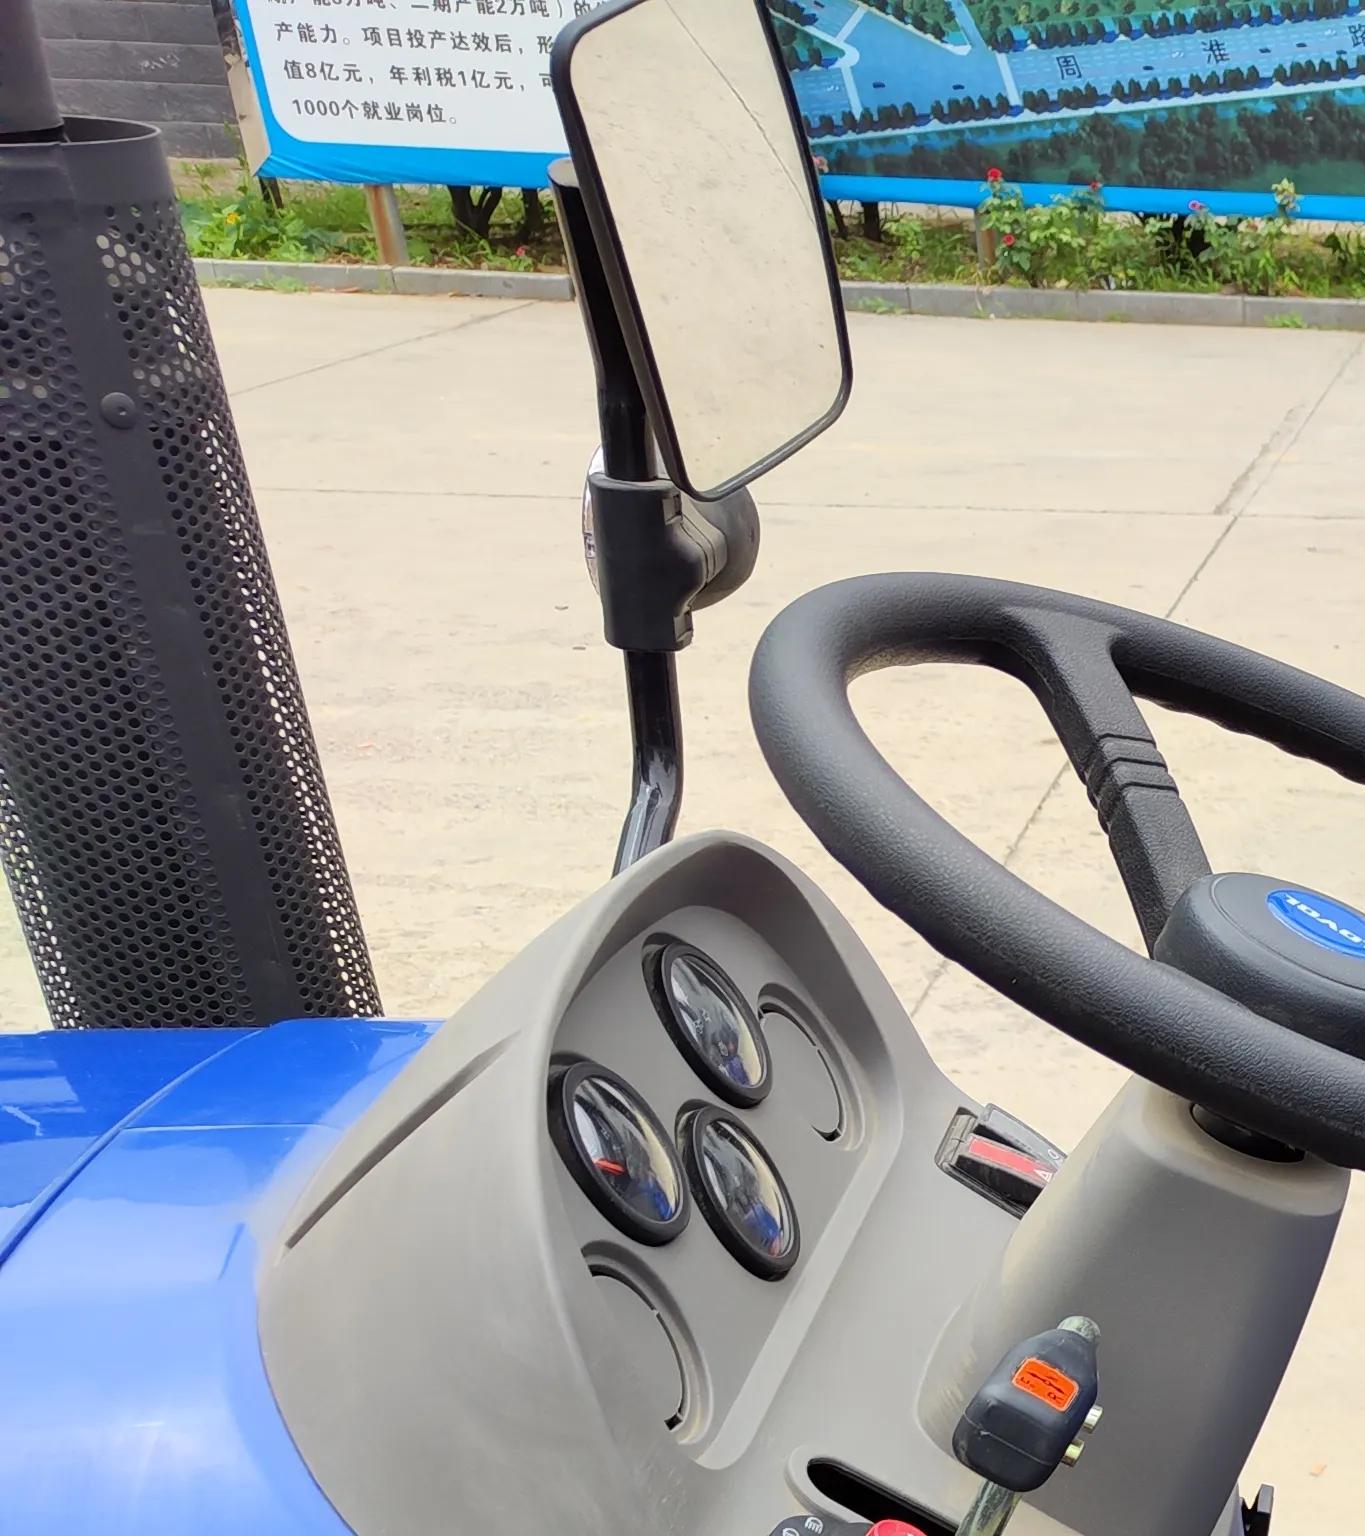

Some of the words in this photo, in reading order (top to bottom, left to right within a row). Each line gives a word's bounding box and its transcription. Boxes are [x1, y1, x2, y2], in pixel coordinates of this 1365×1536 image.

[292, 99, 457, 125] 1000个就业岗位。
